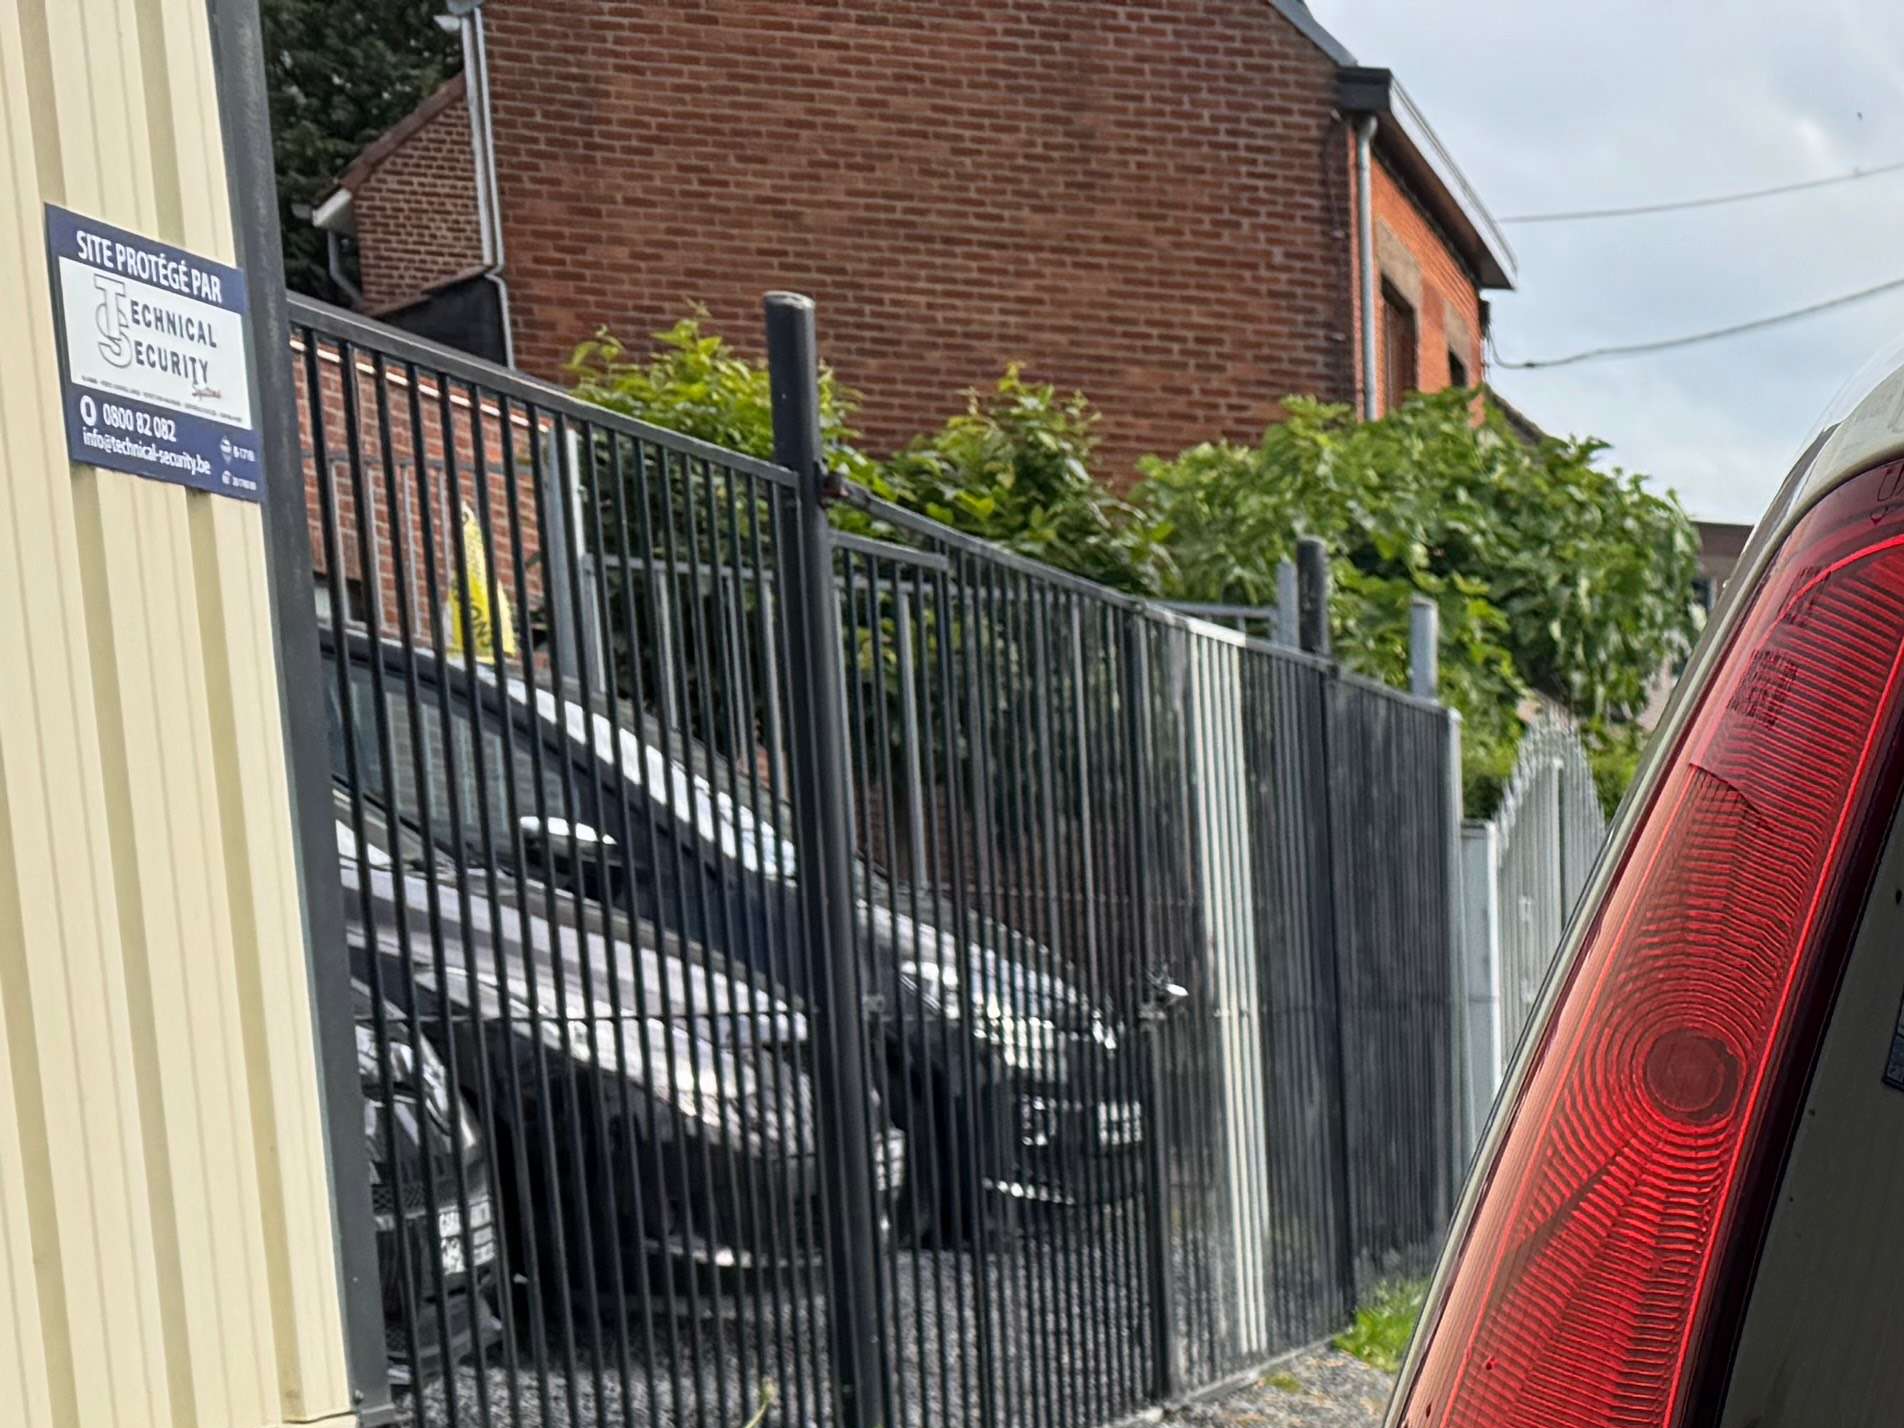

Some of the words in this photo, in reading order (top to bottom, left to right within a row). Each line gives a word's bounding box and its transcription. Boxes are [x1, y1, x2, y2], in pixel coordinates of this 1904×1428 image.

[76, 230, 114, 268] SITE
[115, 243, 190, 294] PROTÉGÉ
[191, 268, 222, 304] PAR
[136, 411, 153, 437] 82
